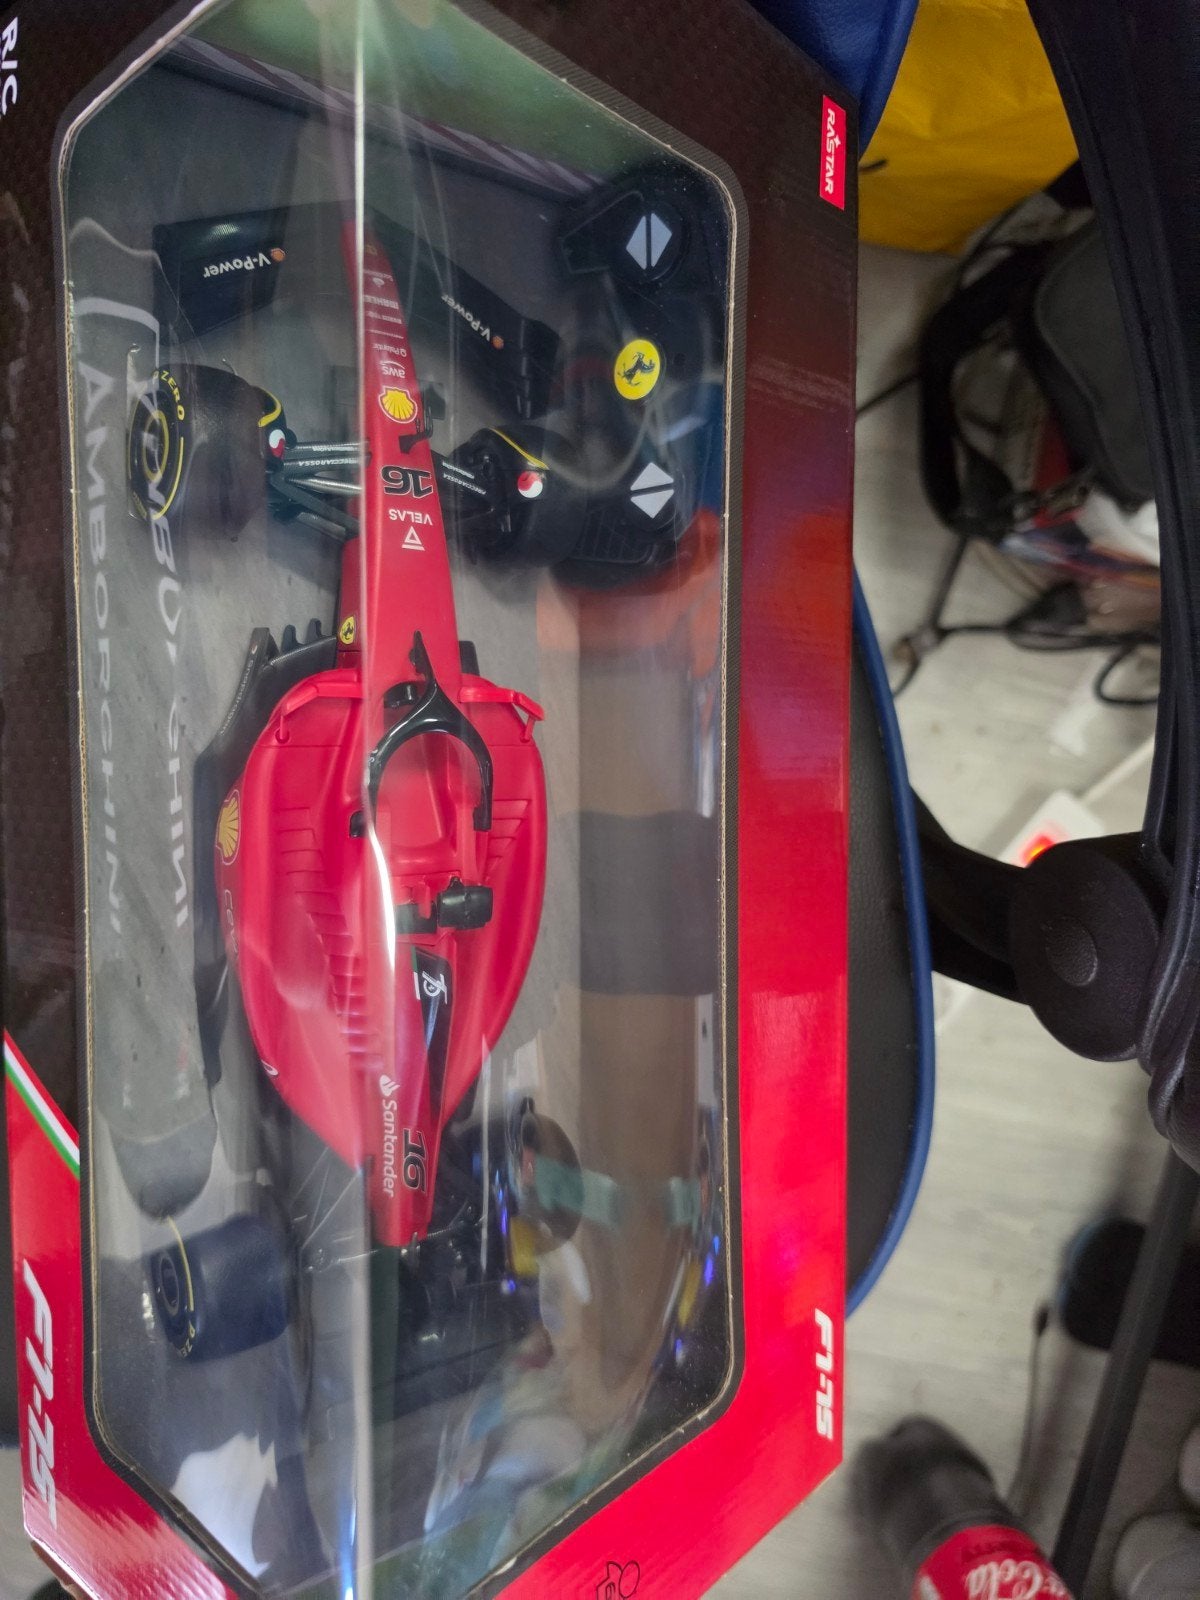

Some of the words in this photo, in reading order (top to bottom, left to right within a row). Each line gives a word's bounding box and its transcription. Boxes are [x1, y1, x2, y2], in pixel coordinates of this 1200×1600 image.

[824, 108, 837, 194] RASTAR
[203, 251, 272, 278] V-Power
[441, 294, 492, 342] V-Power
[161, 370, 185, 421] ZERO
[382, 365, 406, 379] aws
[380, 464, 434, 499] 16
[388, 507, 434, 526] VELAS
[382, 1098, 398, 1199] Santander
[402, 1127, 429, 1196] 16
[22, 1257, 58, 1531] F1-75
[814, 1307, 834, 1441] F1-75
